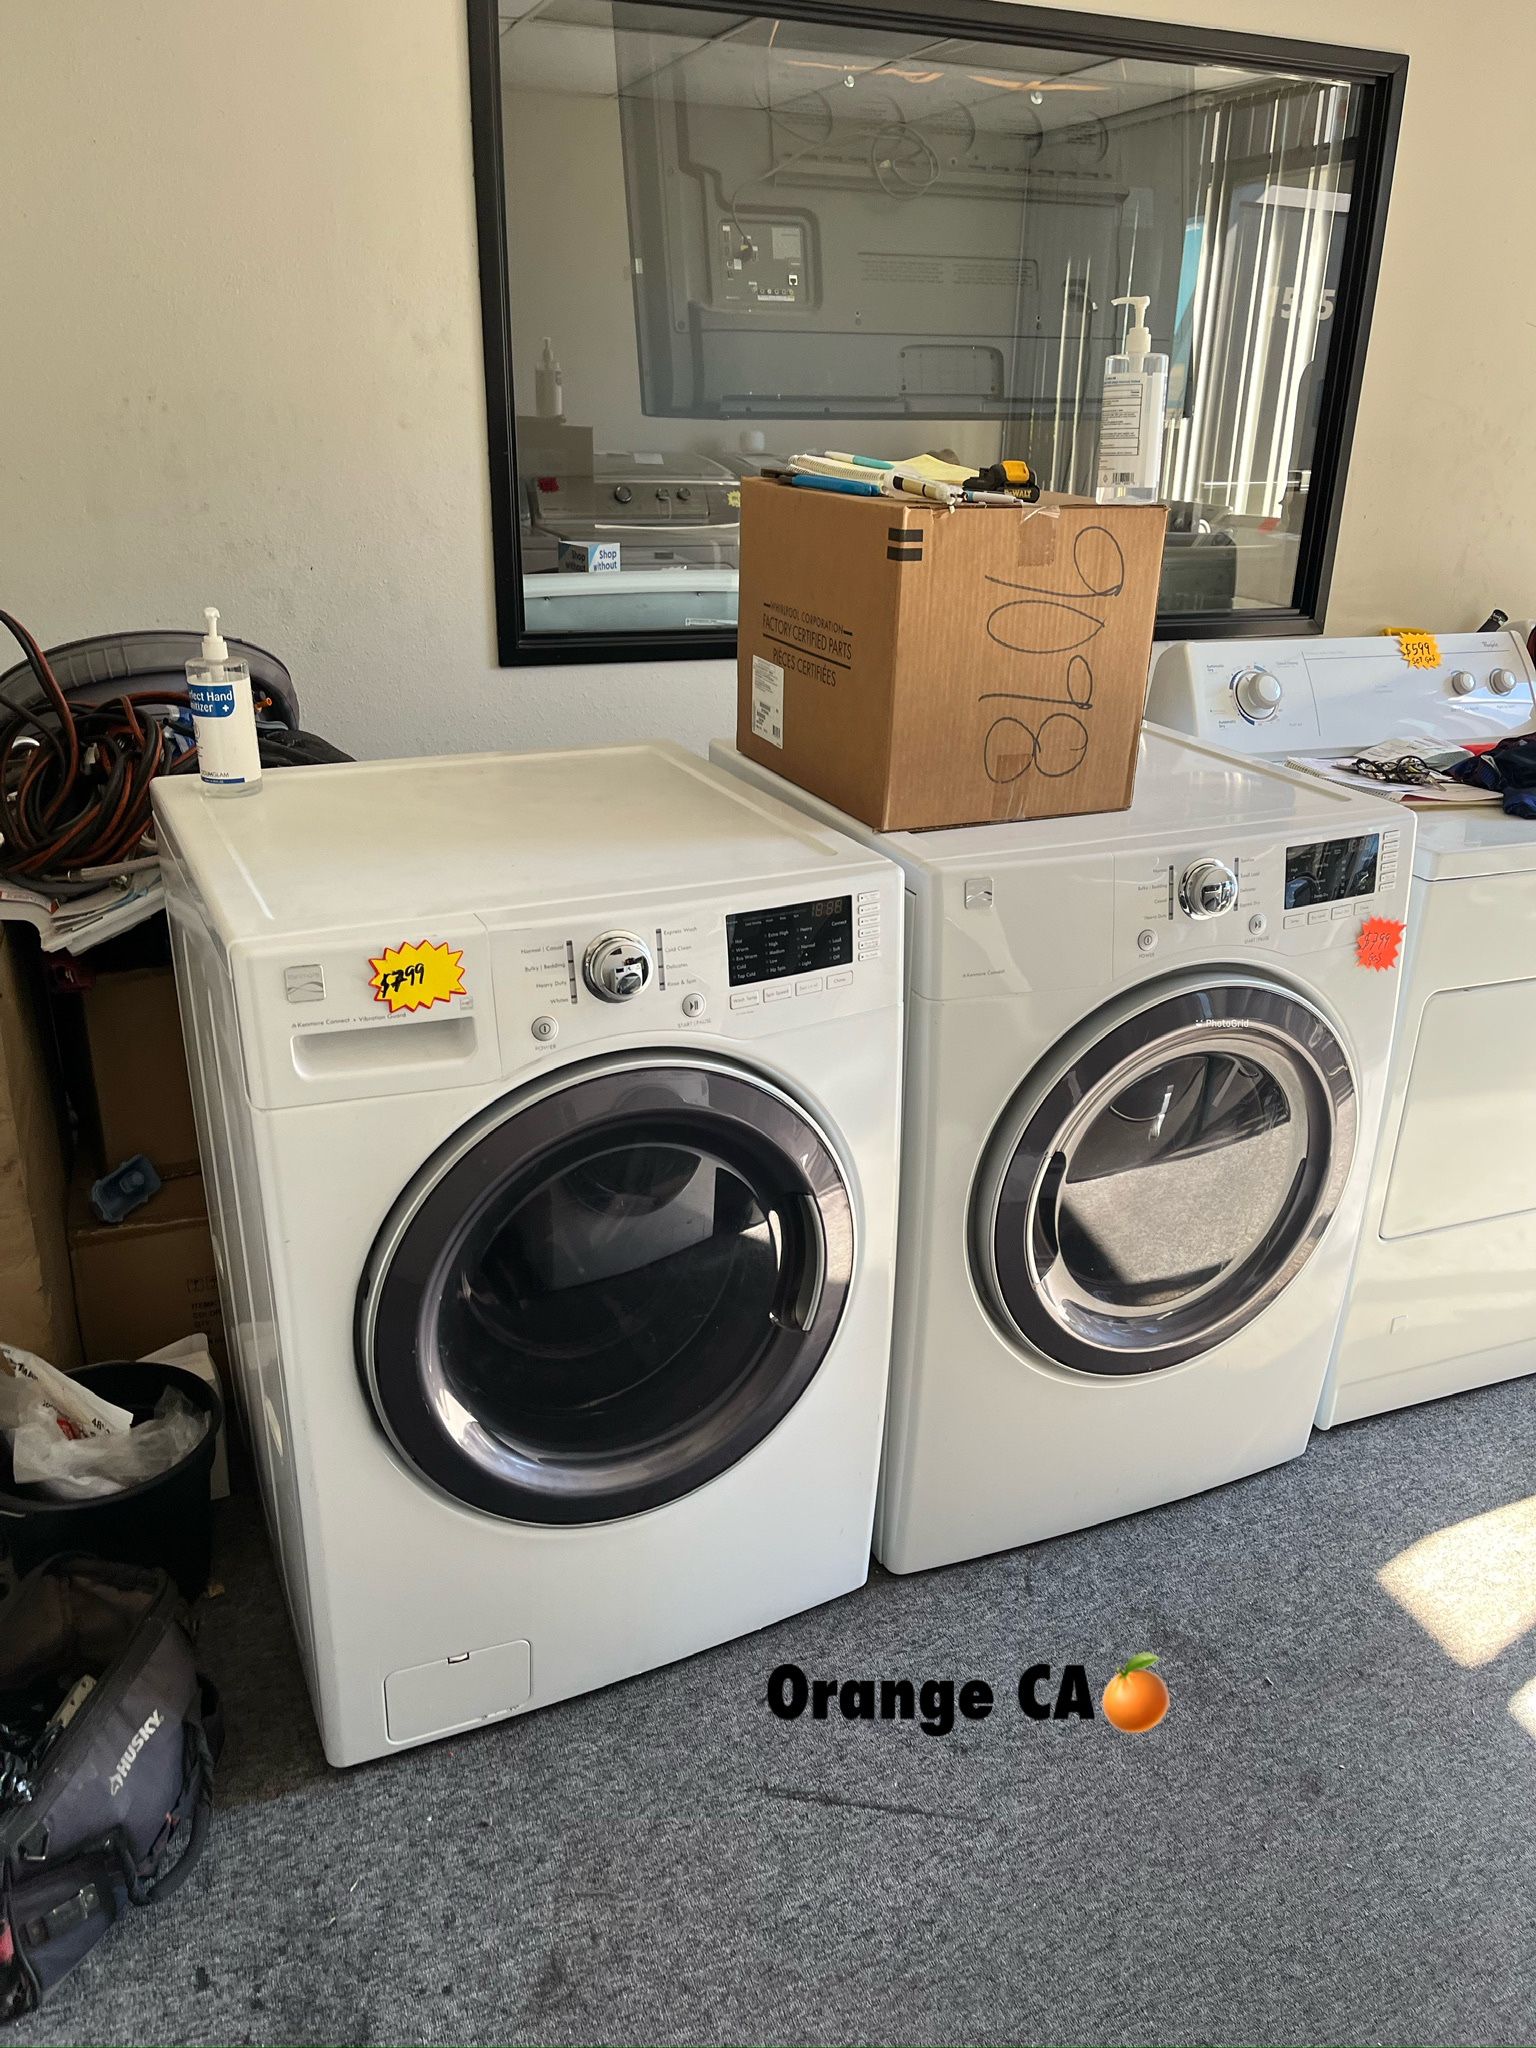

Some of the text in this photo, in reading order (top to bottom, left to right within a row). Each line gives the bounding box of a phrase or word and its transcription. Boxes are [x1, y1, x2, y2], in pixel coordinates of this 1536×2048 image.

[593, 561, 617, 571] without
[599, 549, 617, 560] Shop
[771, 601, 844, 634] WHIRLPOOL CORPORATION
[762, 613, 852, 660] FACTORY CERTIFIED PARTS
[1405, 641, 1430, 657] $599
[772, 647, 836, 687] PIÈCES CERTIFIÉES
[206, 690, 233, 702] Hand
[380, 962, 425, 998] $799
[326, 1017, 351, 1025] Connect
[358, 1015, 386, 1023] Vibration
[116, 1709, 161, 1778] HUSKY
